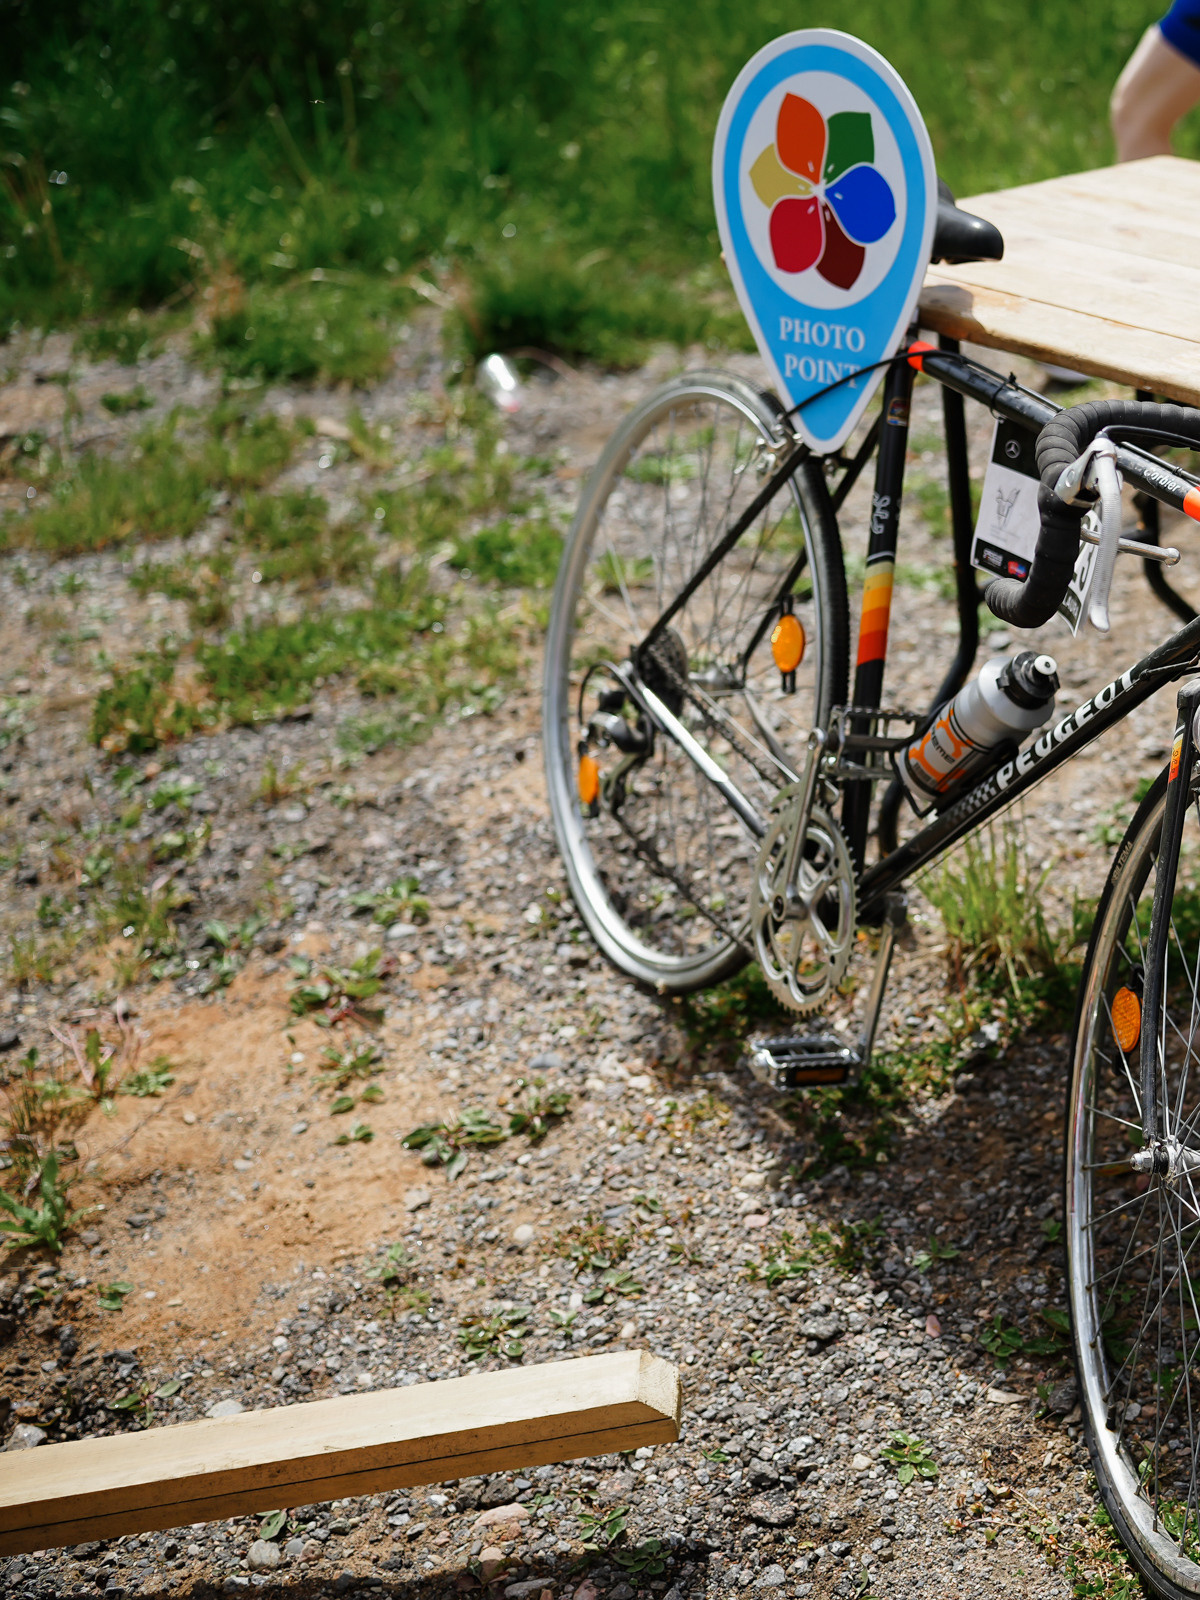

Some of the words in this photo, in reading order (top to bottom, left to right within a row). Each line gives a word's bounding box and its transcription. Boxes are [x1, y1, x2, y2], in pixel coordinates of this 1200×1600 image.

[779, 316, 866, 353] PHOTO
[784, 353, 862, 388] POINT
[996, 664, 1138, 790] PEUGEOT
